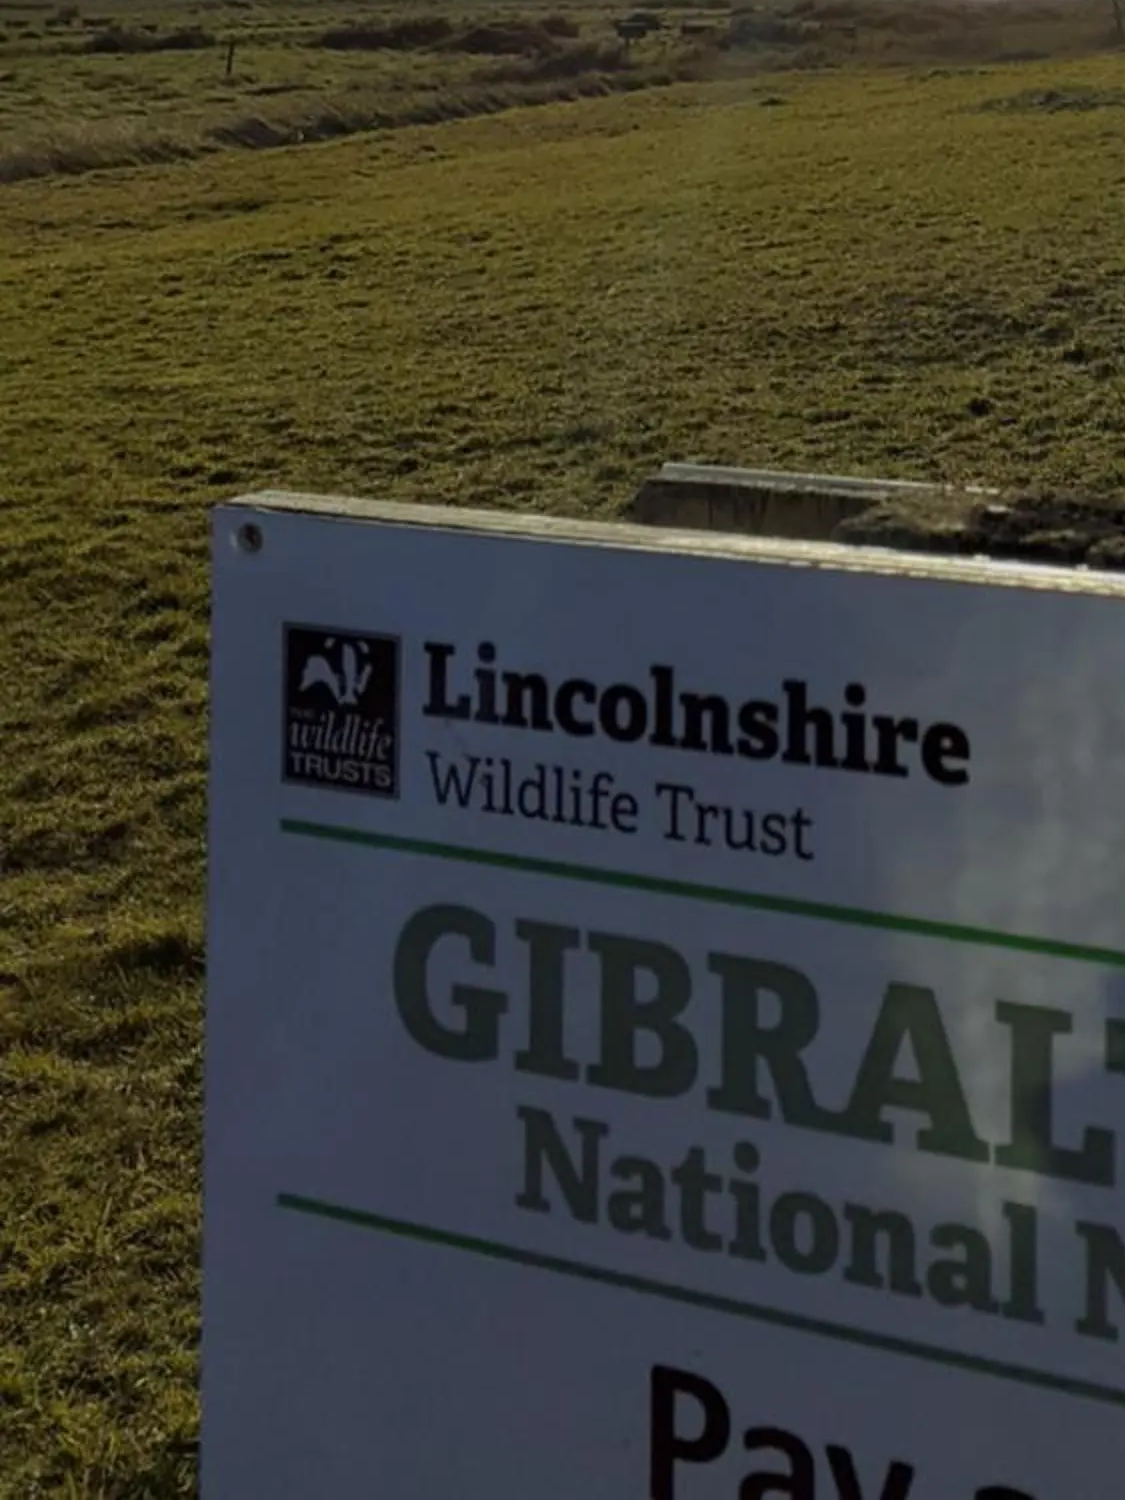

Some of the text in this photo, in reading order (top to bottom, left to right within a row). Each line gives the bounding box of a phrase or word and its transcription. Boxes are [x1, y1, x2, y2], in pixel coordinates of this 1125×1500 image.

[290, 711, 392, 762] wildlife
[422, 642, 971, 786] Lincolnshire
[291, 751, 392, 788] TRUSTS
[426, 752, 814, 861] Wildlife Trust
[515, 1105, 1044, 1324] National
